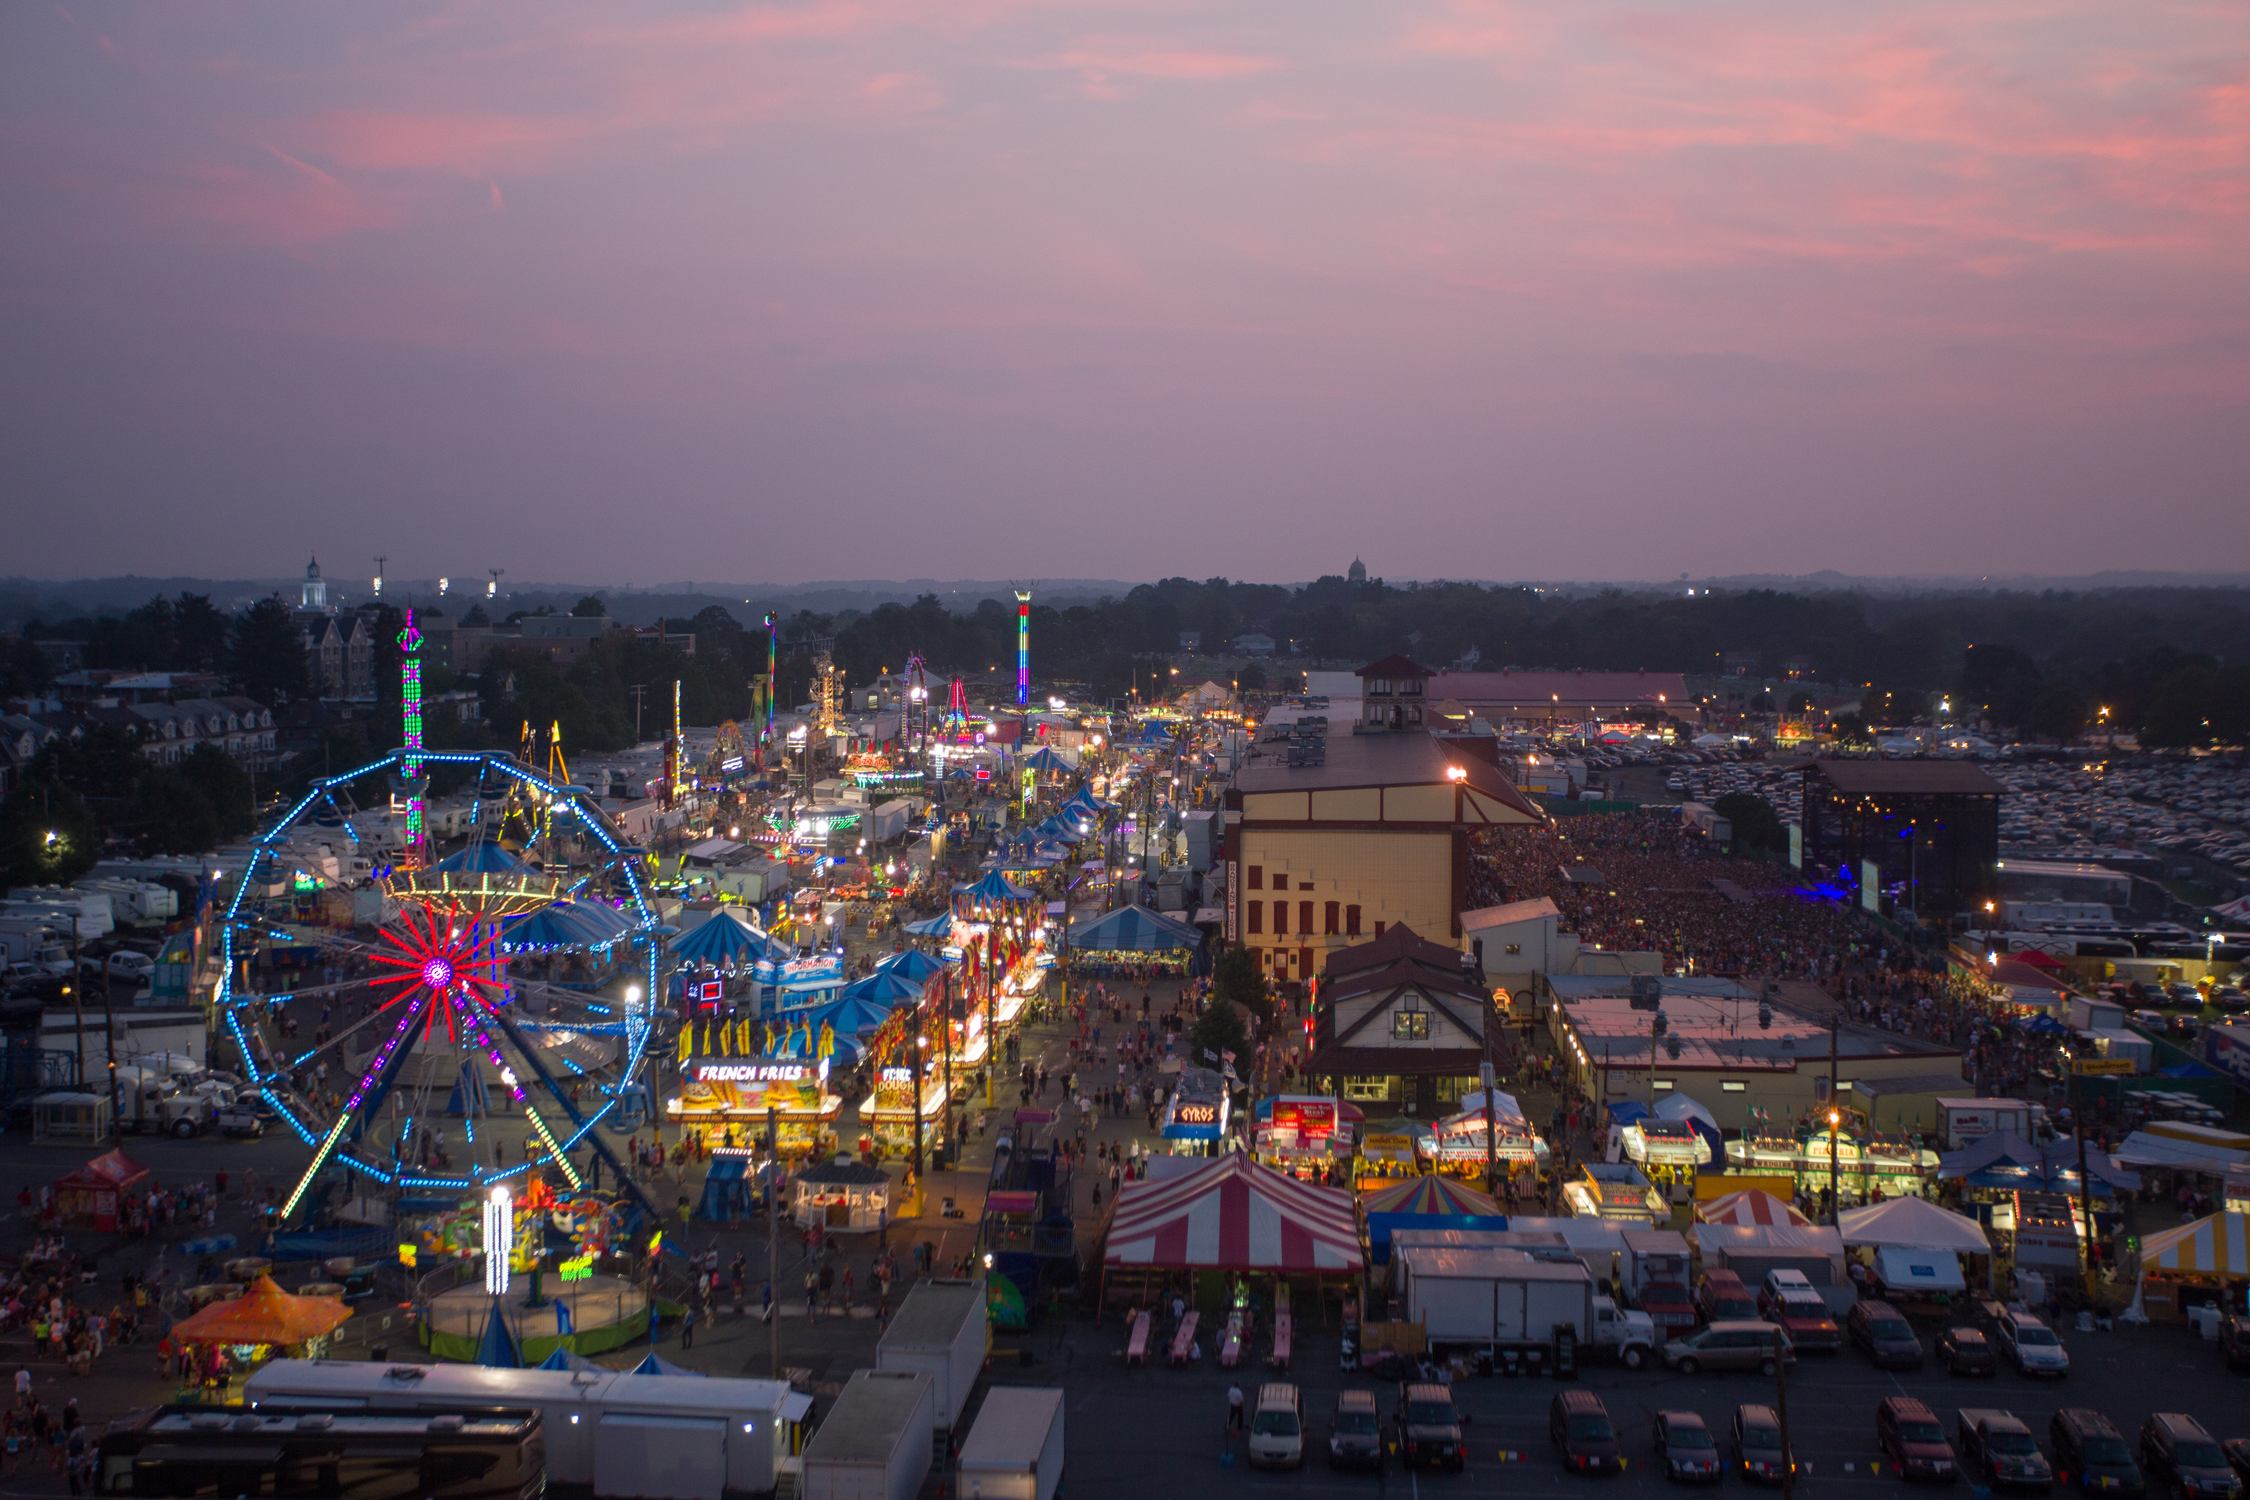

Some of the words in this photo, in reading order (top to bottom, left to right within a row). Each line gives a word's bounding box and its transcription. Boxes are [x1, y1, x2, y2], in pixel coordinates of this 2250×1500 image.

[785, 958, 835, 975] INFORMATION
[699, 1066, 757, 1081] FRENCH
[759, 1066, 803, 1080] FRIES
[878, 1080, 915, 1092] DOUGH
[1181, 1105, 1214, 1122] GYROS
